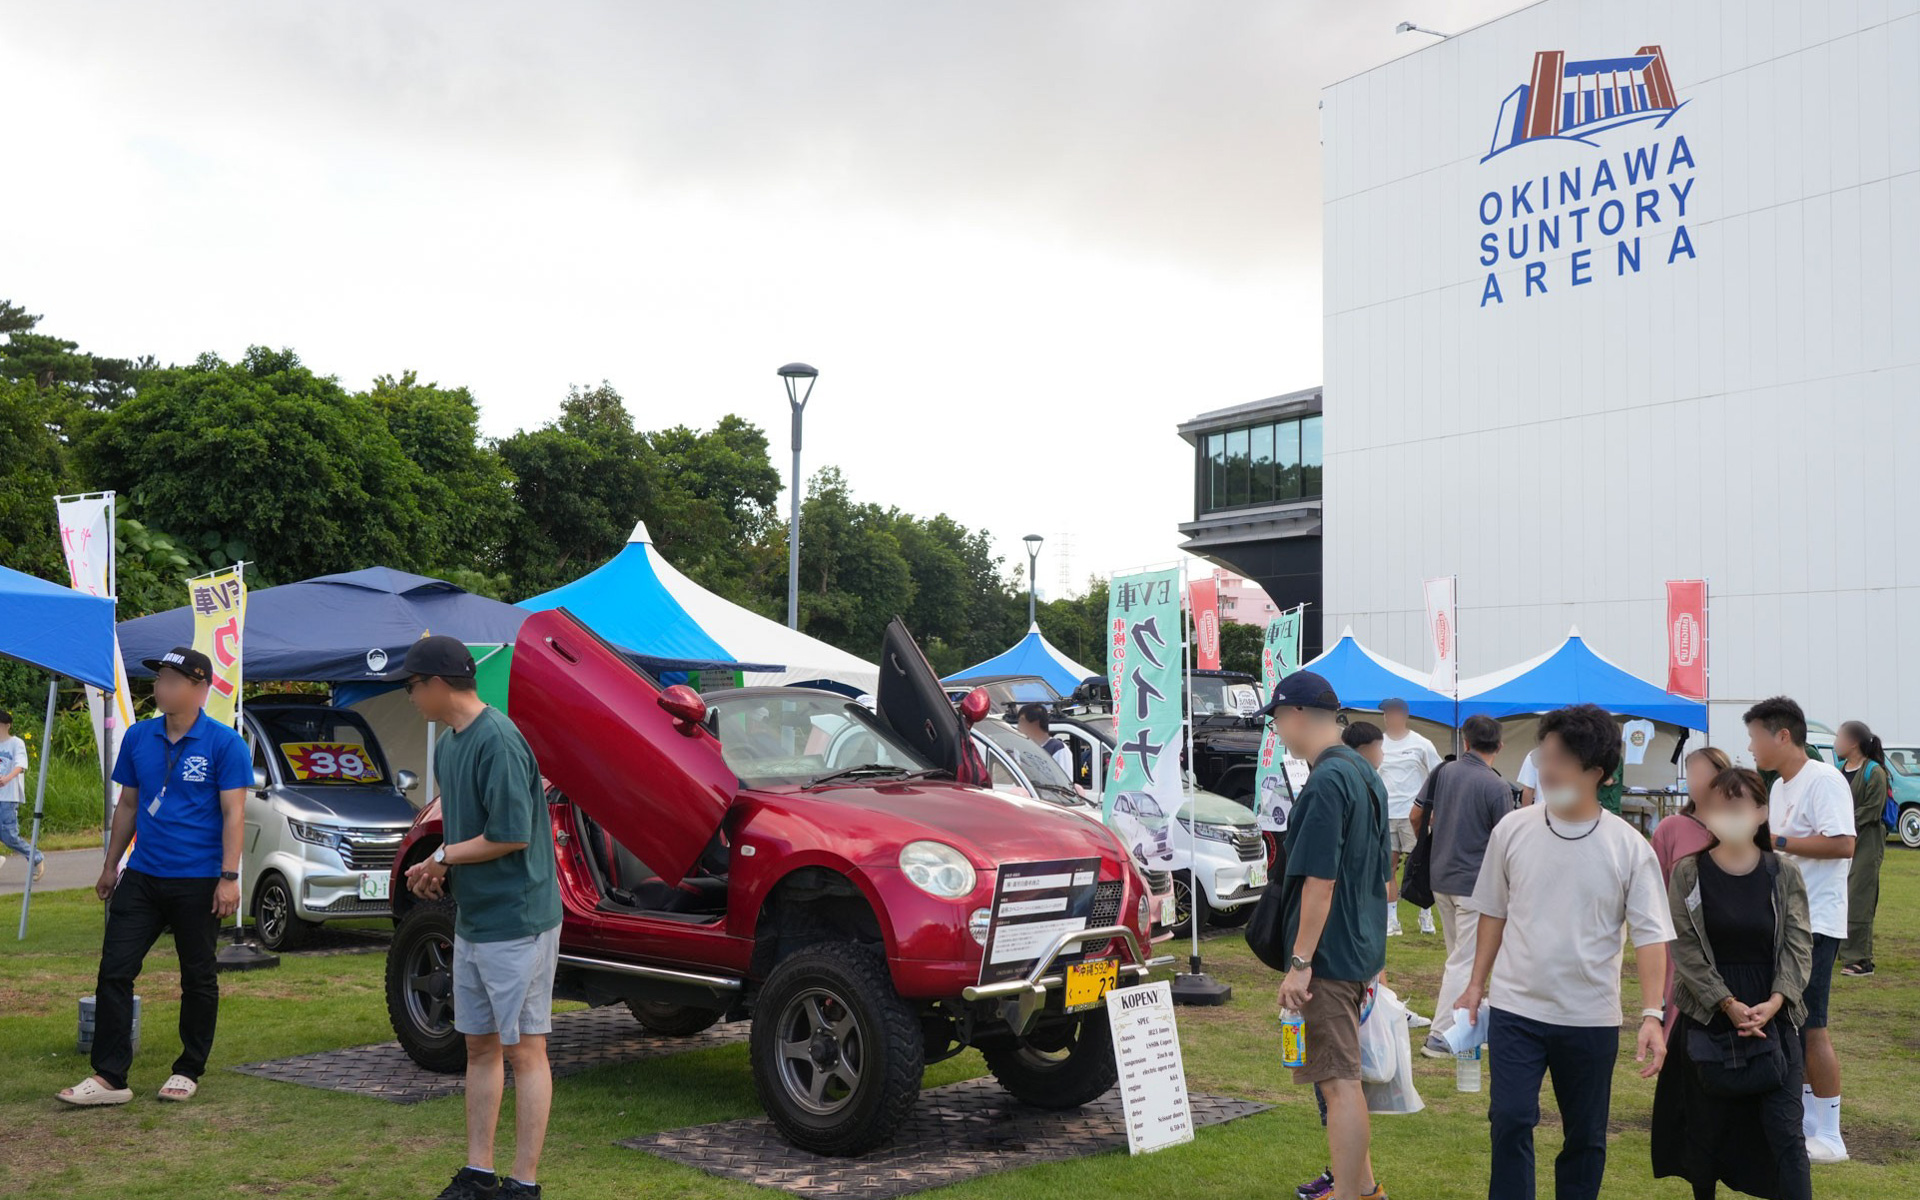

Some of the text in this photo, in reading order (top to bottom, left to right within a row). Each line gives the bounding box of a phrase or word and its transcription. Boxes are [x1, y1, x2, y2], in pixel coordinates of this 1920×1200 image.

[1479, 135, 1695, 226] OKINAWA
[1479, 177, 1695, 267] SUNTORY
[1480, 225, 1696, 308] ARENA
[310, 752, 364, 776] 39
[1121, 989, 1158, 1010] KOPENY
[1137, 1016, 1149, 1026] SPEC
